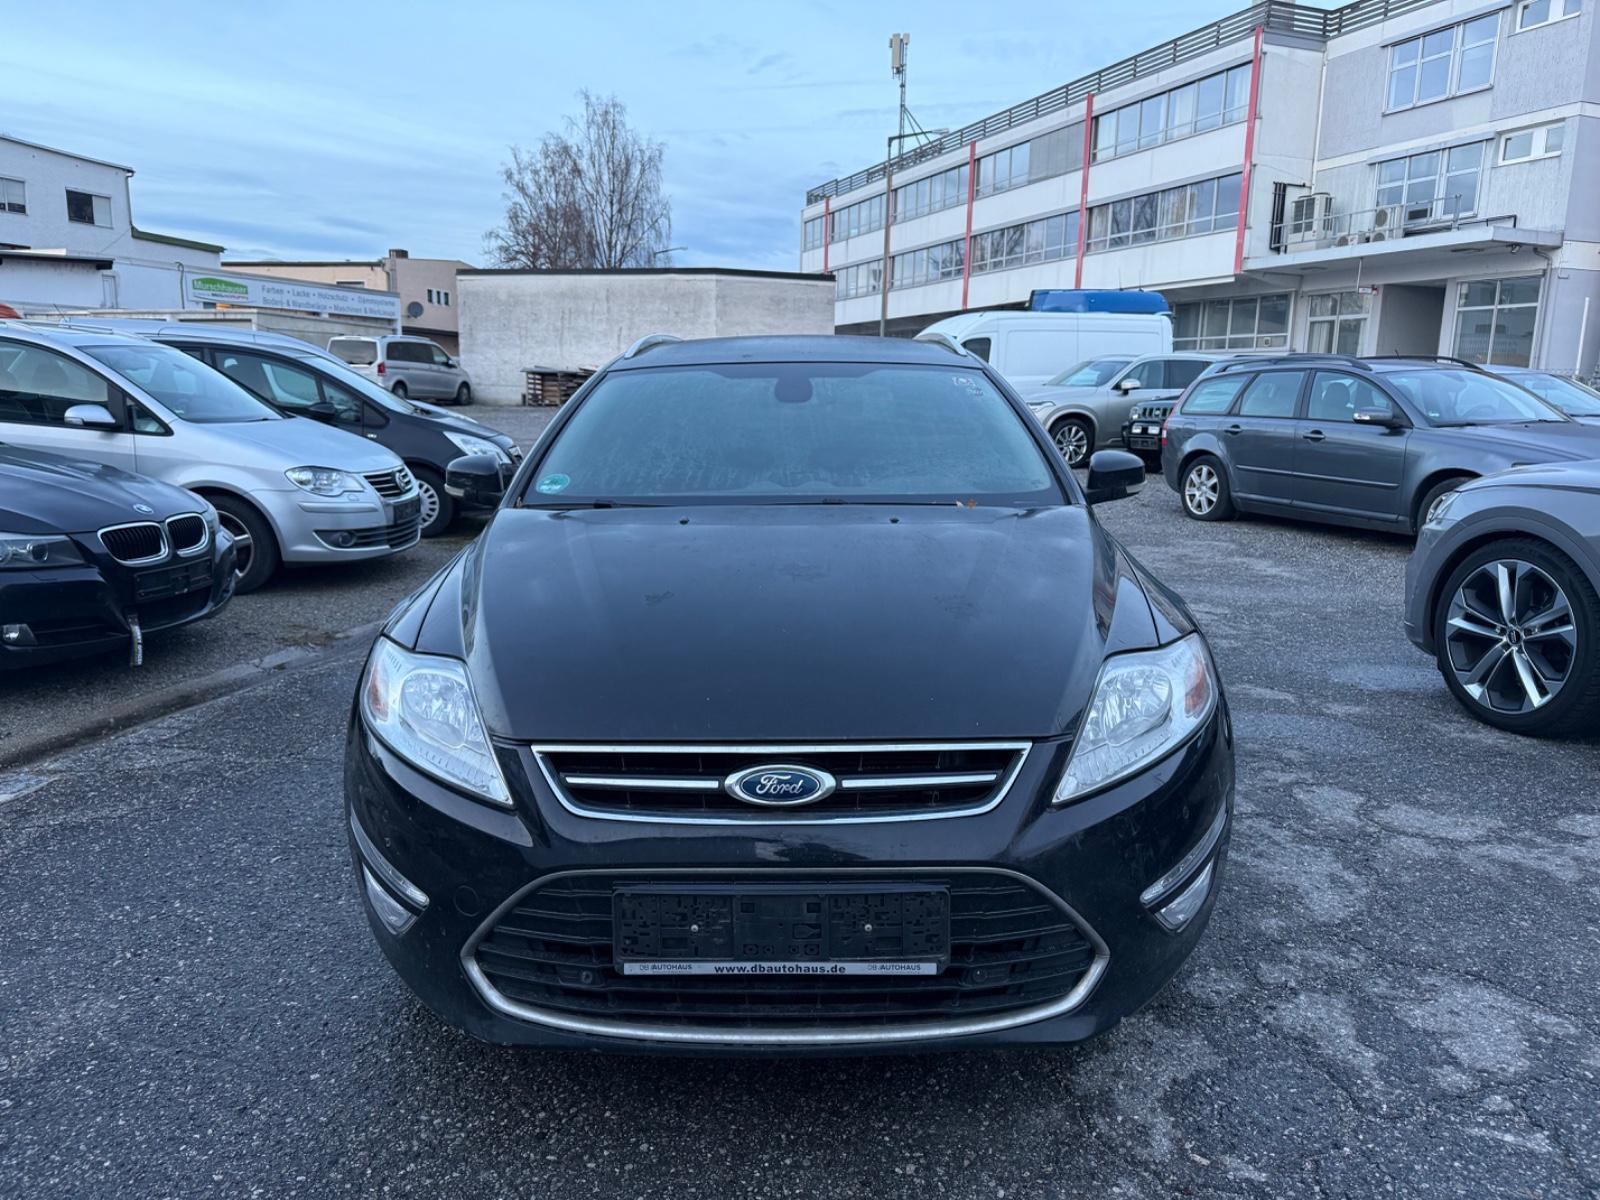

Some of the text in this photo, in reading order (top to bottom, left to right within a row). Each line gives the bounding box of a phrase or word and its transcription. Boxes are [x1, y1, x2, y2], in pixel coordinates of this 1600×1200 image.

[261, 285, 284, 295] Farben
[292, 289, 310, 298] Lacke
[317, 292, 348, 302] Holzschutz
[755, 774, 804, 794] Ford
[714, 963, 846, 975] www.dbautohaus.de
[880, 963, 921, 971] AUTOHAUS
